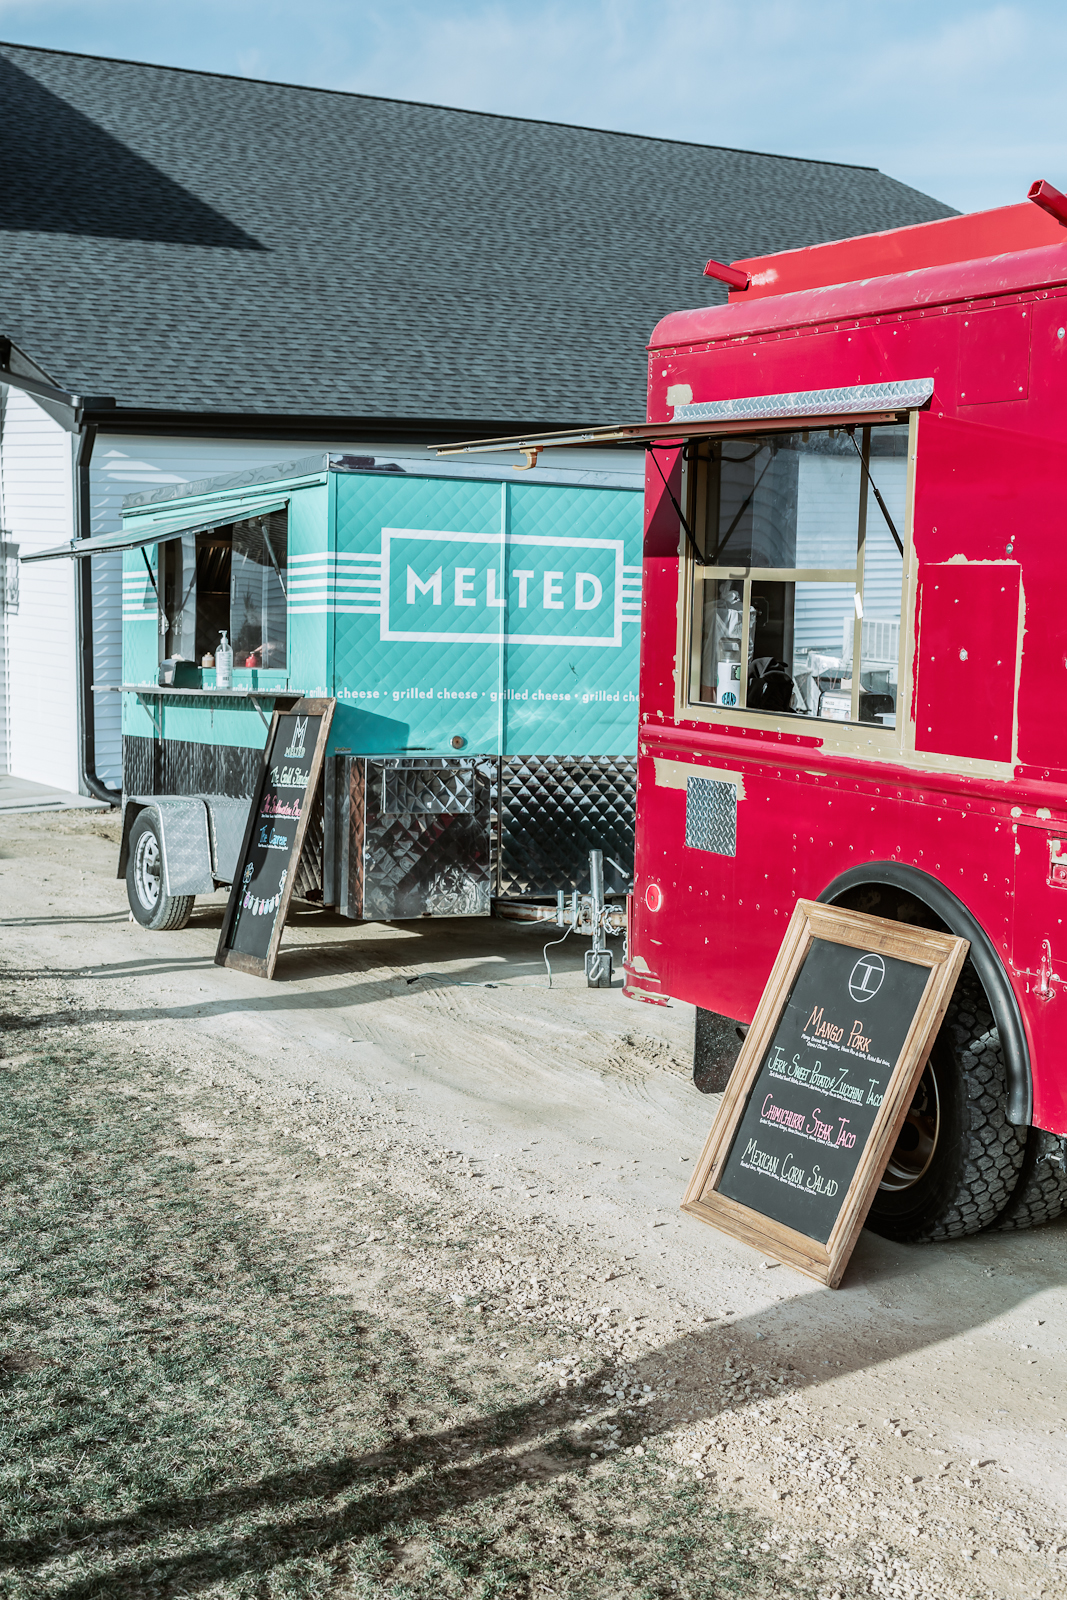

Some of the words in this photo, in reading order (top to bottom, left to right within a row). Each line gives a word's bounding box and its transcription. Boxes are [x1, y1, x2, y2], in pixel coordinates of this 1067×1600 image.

[407, 564, 603, 611] MELTED
[309, 686, 328, 698] grilled
[337, 687, 380, 699] cheese
[392, 687, 434, 702] grilled
[437, 687, 478, 699] cheese
[490, 689, 529, 702] grilled
[531, 689, 571, 700] cheese
[582, 690, 620, 703] grilled
